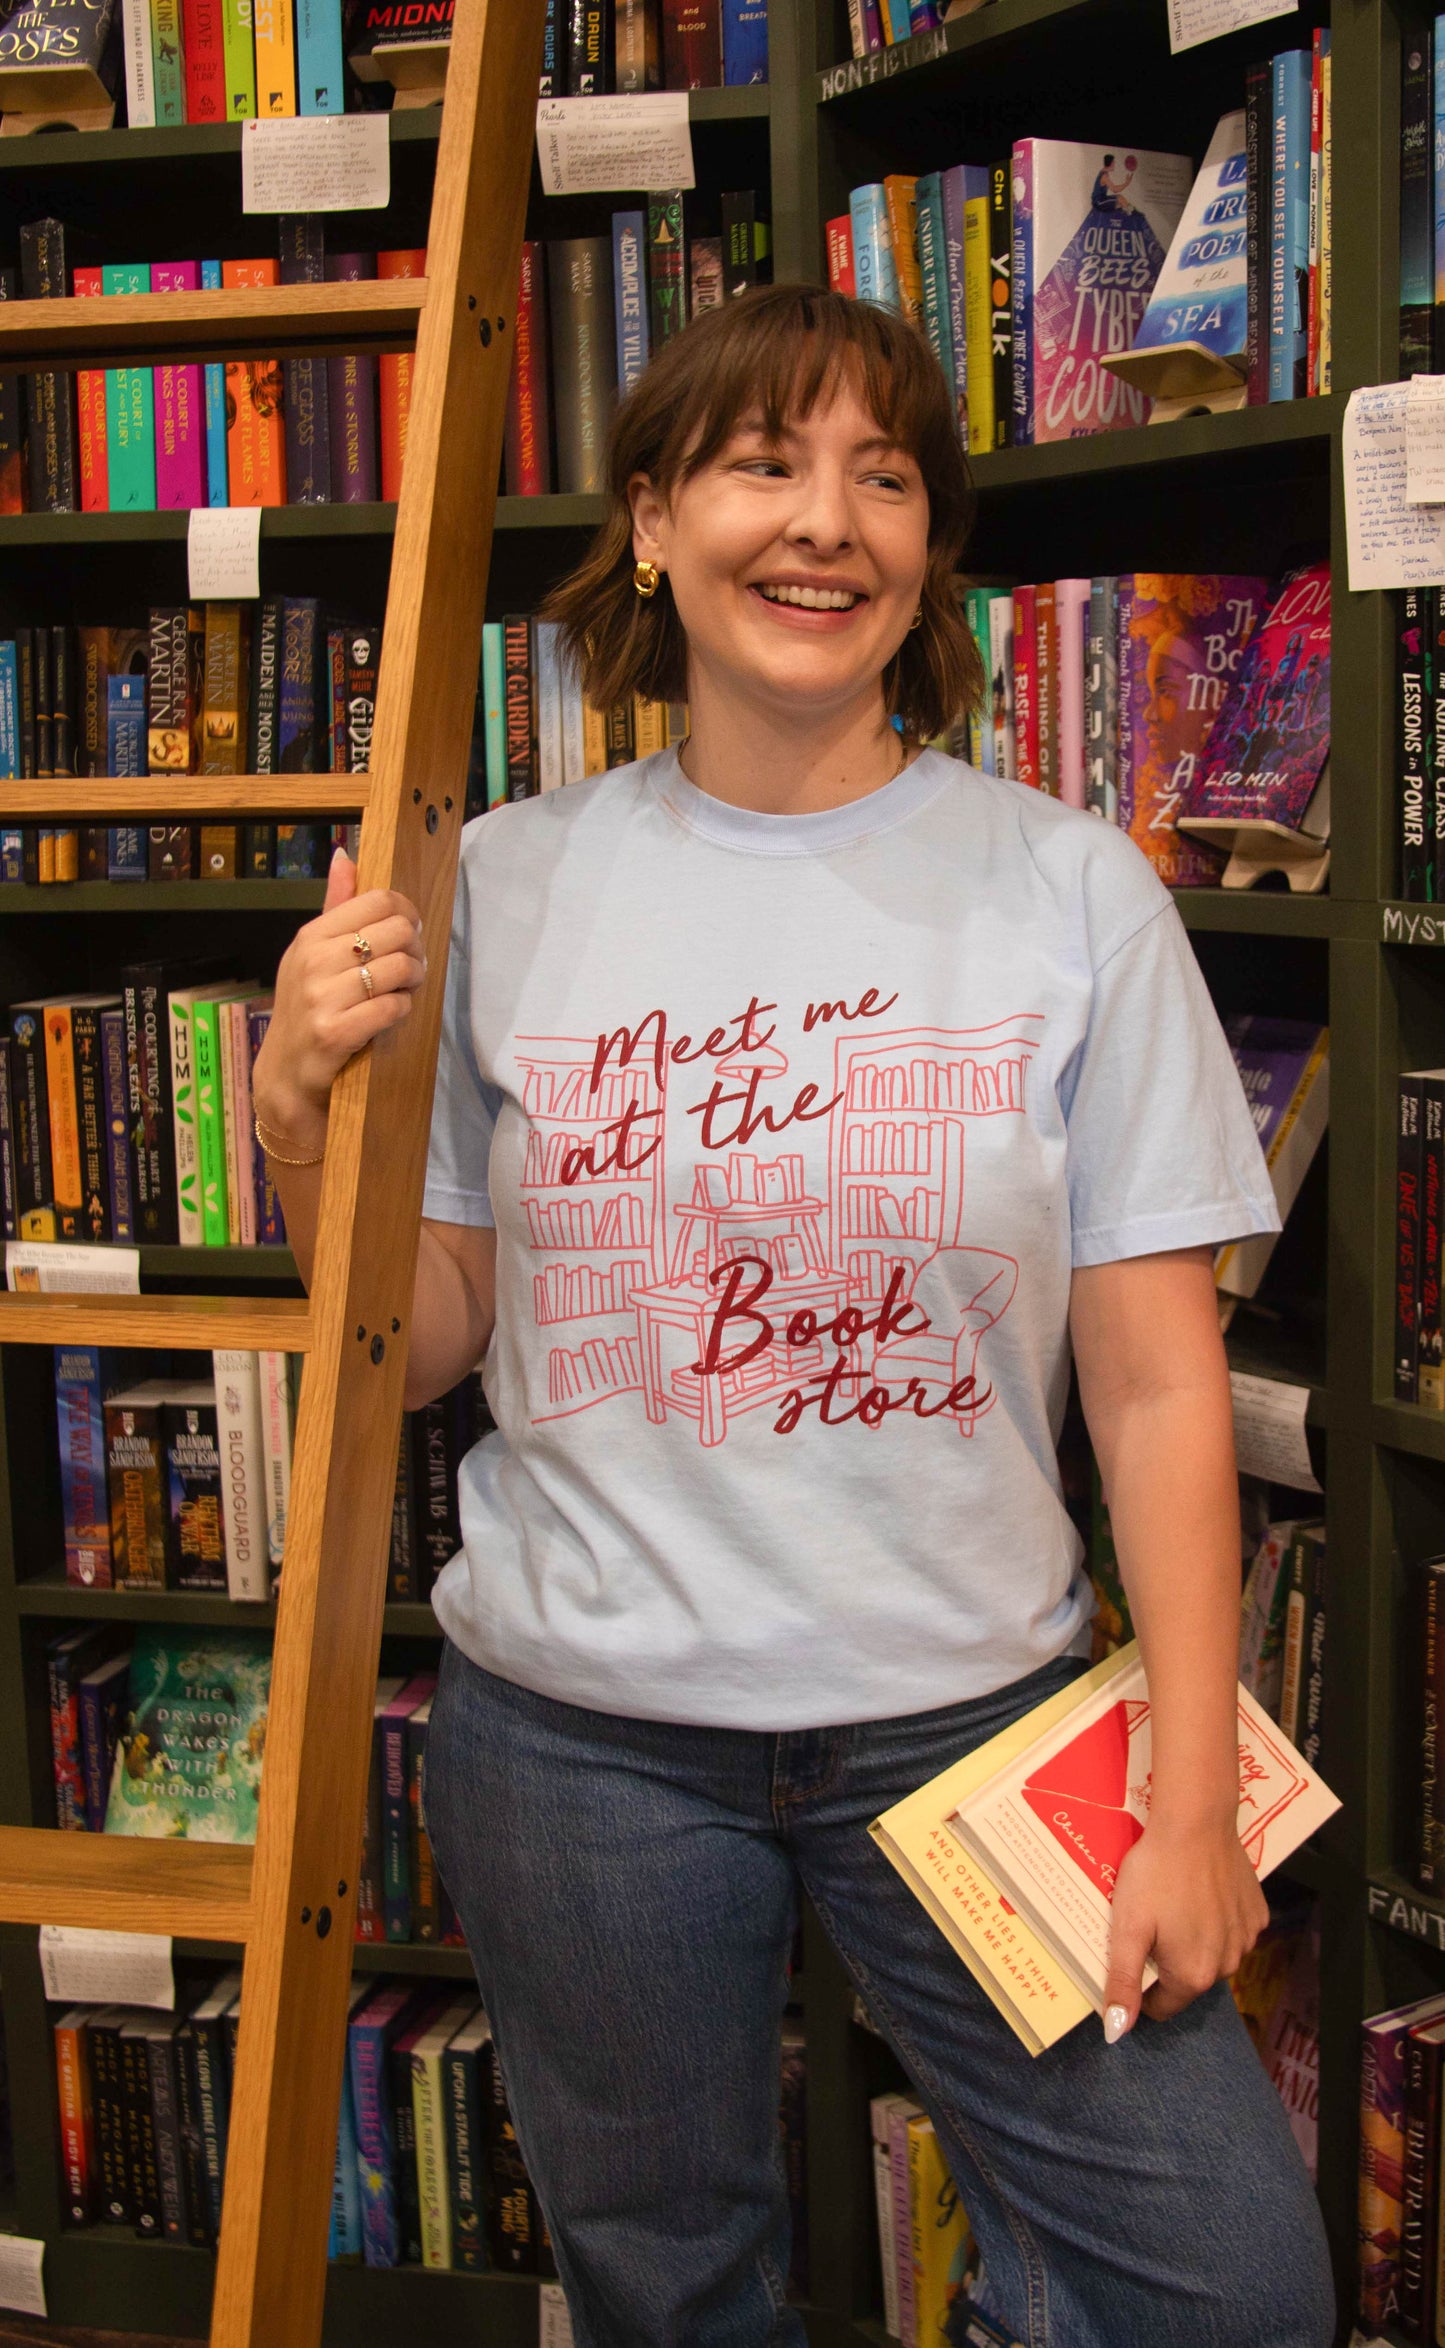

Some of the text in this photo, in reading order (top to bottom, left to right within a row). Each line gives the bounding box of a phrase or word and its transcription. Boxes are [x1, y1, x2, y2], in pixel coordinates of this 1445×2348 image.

[0, 27, 80, 61] OSES
[197, 4, 212, 49] LOVE
[367, 2, 455, 28] MIDNI
[588, 12, 600, 63] DAWN
[677, 22, 706, 32] BLOOD
[549, 133, 564, 189] Shelf Talker
[1083, 227, 1147, 257] QUEEN
[1246, 112, 1259, 313] CONSTELLATION MINOR
[1273, 116, 1287, 336] WHERE YOU SEE YOURSELF
[520, 257, 531, 293] SARAH
[570, 262, 582, 295] MAAS
[582, 252, 593, 289] SARAH
[620, 237, 640, 318] ACCOMPLICE
[829, 230, 840, 281] ALEXANDER
[838, 234, 848, 269] KWAME
[920, 208, 938, 313] UNDER THE
[1077, 256, 1151, 287] BEES
[1187, 236, 1247, 263] POET
[1012, 240, 1027, 416] QUEEN TYBEE COUNTY
[1161, 304, 1223, 338] SEA
[132, 378, 144, 427] COURT
[177, 378, 188, 428] COURT
[297, 358, 316, 446] OF GLASS
[514, 311, 536, 470] QUEEN SHADOWS
[576, 324, 594, 449] KINGDOM ASH
[1045, 355, 1145, 430] COUN
[118, 411, 129, 449] FURY
[164, 419, 175, 456] RUIN
[243, 426, 254, 484] FLAMES
[259, 419, 271, 466] COURT
[346, 412, 360, 475] STORMS
[150, 616, 172, 724] MARTIN
[172, 615, 187, 725] GEORGE R. R.
[208, 631, 225, 703] MARTIN
[260, 615, 277, 690] MAIDEN
[283, 610, 302, 683] MOORE
[86, 643, 97, 752] SWORDCROSSED
[352, 680, 372, 692] MUIR
[505, 622, 530, 765] THE GARDEN
[1015, 673, 1029, 719] RISE
[1037, 622, 1049, 774] THIS THING OF
[1119, 604, 1132, 801] This Book Might Be About
[116, 721, 129, 777] MARTIN
[1204, 772, 1288, 786] LIO MIN
[1403, 673, 1424, 846] LESSONS in POWER
[105, 1022, 125, 1115] ENLIGHTENMENT
[125, 987, 141, 1112] BRISTOL KEATS
[146, 1012, 161, 1097] COURTING
[175, 1026, 192, 1080] HUM
[199, 1036, 211, 1077] HUM
[589, 988, 899, 1094] Meet me
[82, 1064, 101, 1189] A FAR BETTER THING
[561, 1068, 846, 1186] at the
[137, 1147, 148, 1200] PEARSON
[1398, 1171, 1419, 1266] ONE US
[1424, 1153, 1439, 1317] NOTHING TELL
[692, 1256, 932, 1376] Book
[58, 1366, 95, 1381] SANDERSON
[61, 1354, 92, 1366] BRANDON
[773, 1356, 993, 1434] store
[69, 1385, 97, 1538] THE WAY KINGS
[109, 1451, 156, 1468] SANDERSON
[112, 1436, 150, 1451] BRANDON
[171, 1449, 220, 1466] SANDERSON
[176, 1434, 214, 1450] BRANDON
[123, 1471, 150, 1572] OATHBRINGER
[198, 1495, 221, 1561] RHYTHM
[229, 1431, 251, 1562] BLOODGUARD
[180, 1522, 200, 1555] WAR
[156, 1708, 242, 1726] DRAGON
[184, 1686, 223, 1700] THE
[163, 1734, 230, 1750] WAKES
[165, 1757, 218, 1773] WITH
[1421, 1703, 1438, 1770] SCARLET
[140, 1781, 238, 1801] THUNDER
[1004, 1810, 1067, 1887] MODERN GUIDE TO
[1053, 1811, 1098, 1865] Chelsea
[996, 1819, 1093, 1936] AND ATTENDING EVERY TYPE
[925, 1848, 1039, 1999] WILL MAKE ME HAPPY
[929, 1830, 1059, 2001] AND OTHER LIES THINK
[62, 2038, 82, 2195] THE MARTIAN ANDY WEIR
[151, 2043, 180, 2219] ARTEMIS ANDY WEIR
[197, 2049, 220, 2177] SECOND CHANCE CINEMA
[452, 2062, 473, 2202] UPON STARLIT TIDE
[501, 2196, 516, 2233] WING
[514, 2188, 529, 2243] FOURTH
[1406, 2129, 1424, 2292] BETRAYED
